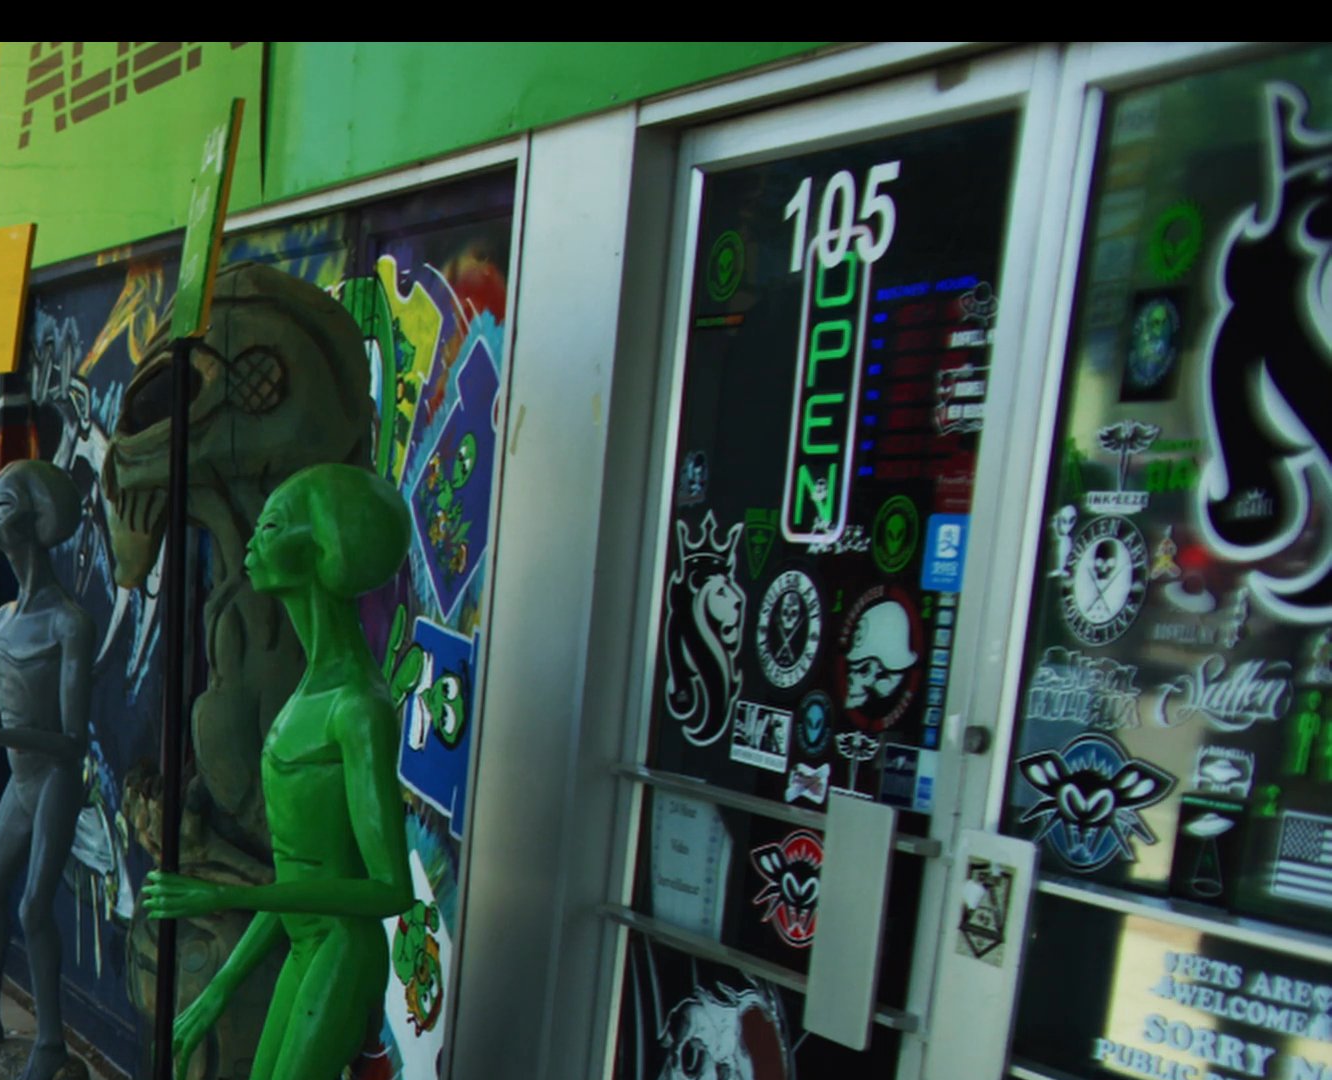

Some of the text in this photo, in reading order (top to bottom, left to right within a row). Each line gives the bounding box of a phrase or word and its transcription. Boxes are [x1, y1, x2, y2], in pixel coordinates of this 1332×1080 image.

[782, 160, 902, 273] 105
[793, 250, 859, 528] OPEN
[1173, 983, 1309, 1036] WELCOME
[1177, 953, 1312, 1008] PETS ARE
[1143, 1012, 1276, 1078] SORRY
